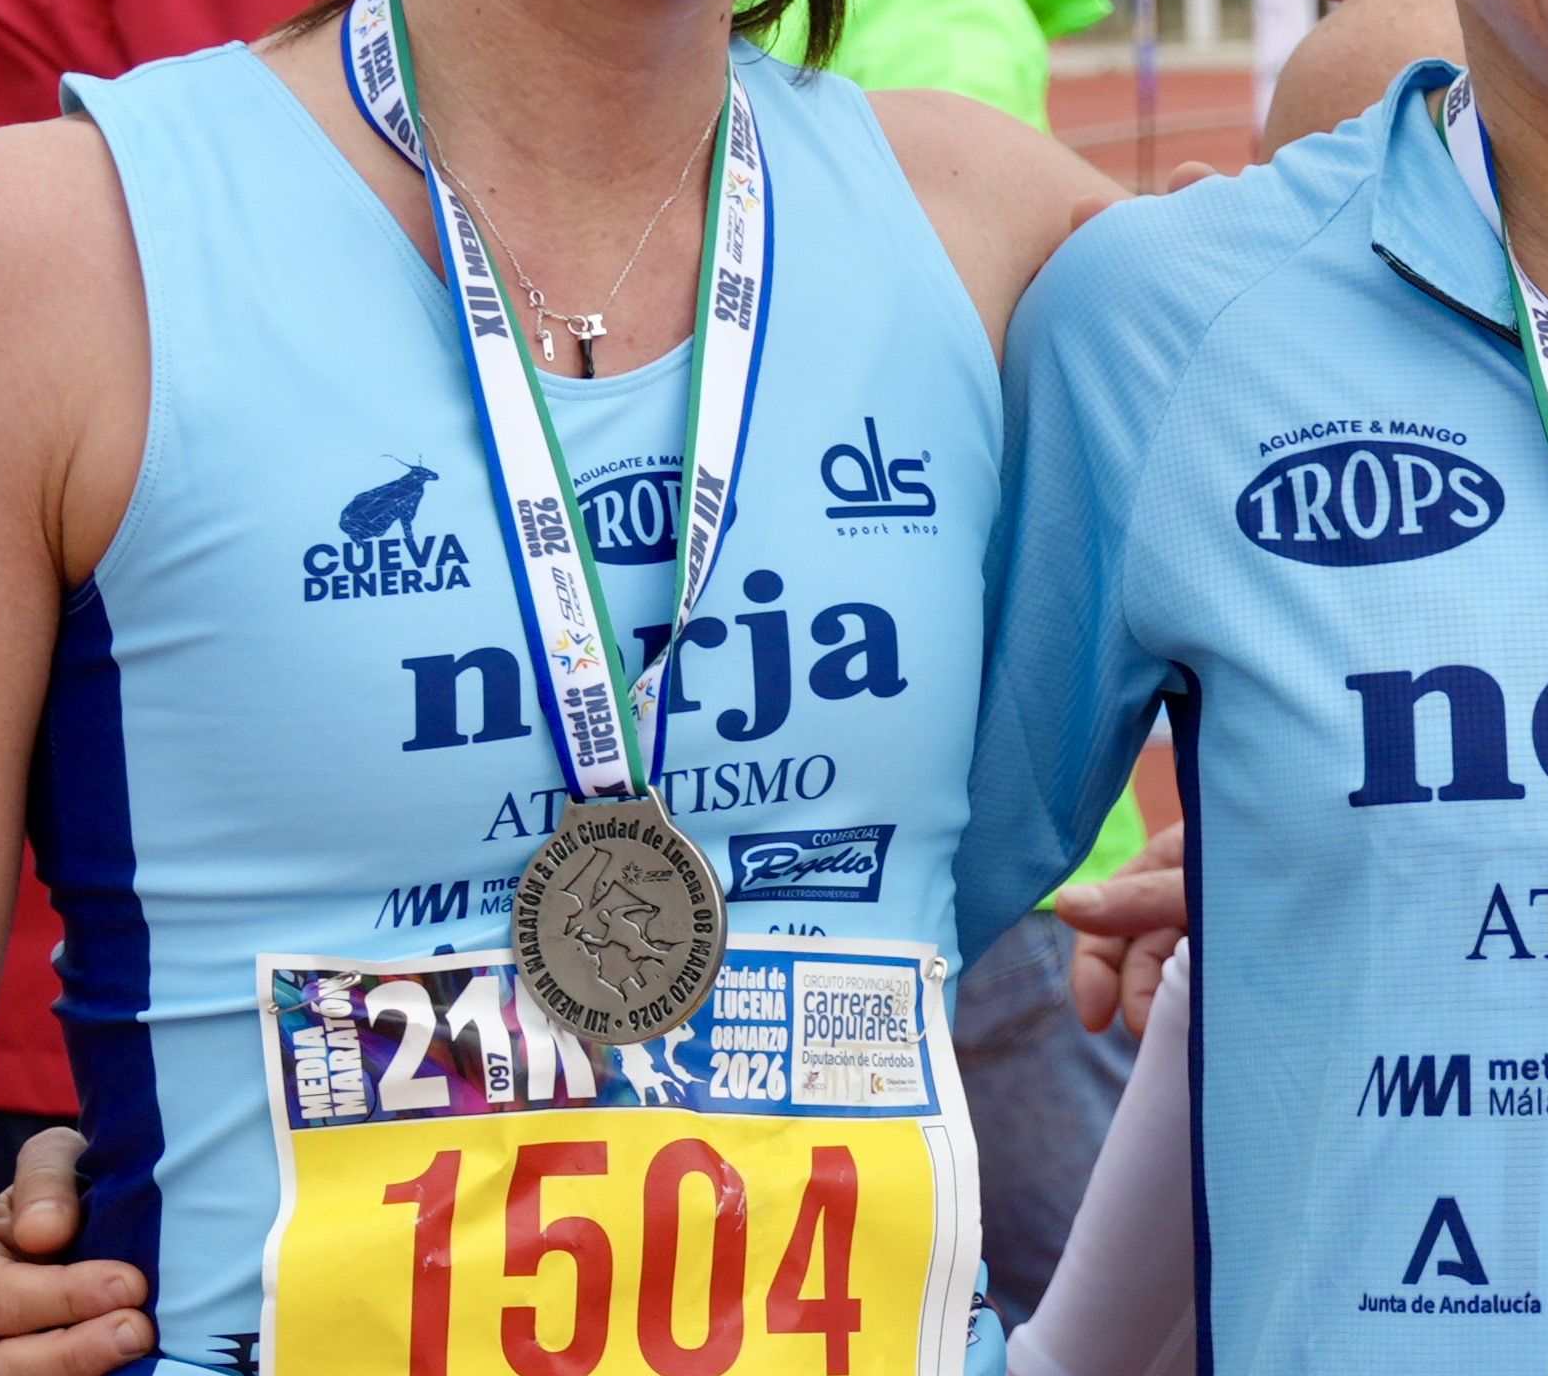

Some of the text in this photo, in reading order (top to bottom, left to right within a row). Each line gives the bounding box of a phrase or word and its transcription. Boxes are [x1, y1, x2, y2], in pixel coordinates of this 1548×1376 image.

[447, 194, 510, 339] XII MEDIA
[714, 266, 742, 323] 2026
[1258, 420, 1468, 457] AGUACATE & MANGO
[818, 416, 937, 516] als
[694, 464, 725, 528] XII
[1249, 449, 1491, 542] TROPS
[517, 499, 543, 558] 08MARZO
[533, 496, 571, 556] 2026
[835, 516, 940, 538] sport shop
[302, 532, 470, 579] CUEVA
[303, 562, 471, 602] DENERJA
[563, 708, 595, 768] Ciudad
[582, 682, 620, 768] LUCENA
[577, 816, 641, 846] Ciudad
[715, 965, 787, 990] Ciudad de
[803, 973, 895, 992] CIRCUITO PROVINCIAL
[712, 988, 787, 1022] LUCENA
[803, 990, 894, 1018] carreras
[310, 977, 369, 1117] MARATÓN
[710, 1024, 788, 1053] 08MARZO
[803, 1006, 909, 1047] populares
[293, 1025, 335, 1119] MEDIA
[487, 1051, 510, 1092] 097
[709, 1050, 787, 1102] 2026
[802, 1050, 915, 1068] Diputación de Córdoba
[1357, 1291, 1542, 1315] Junta de Andalucía
